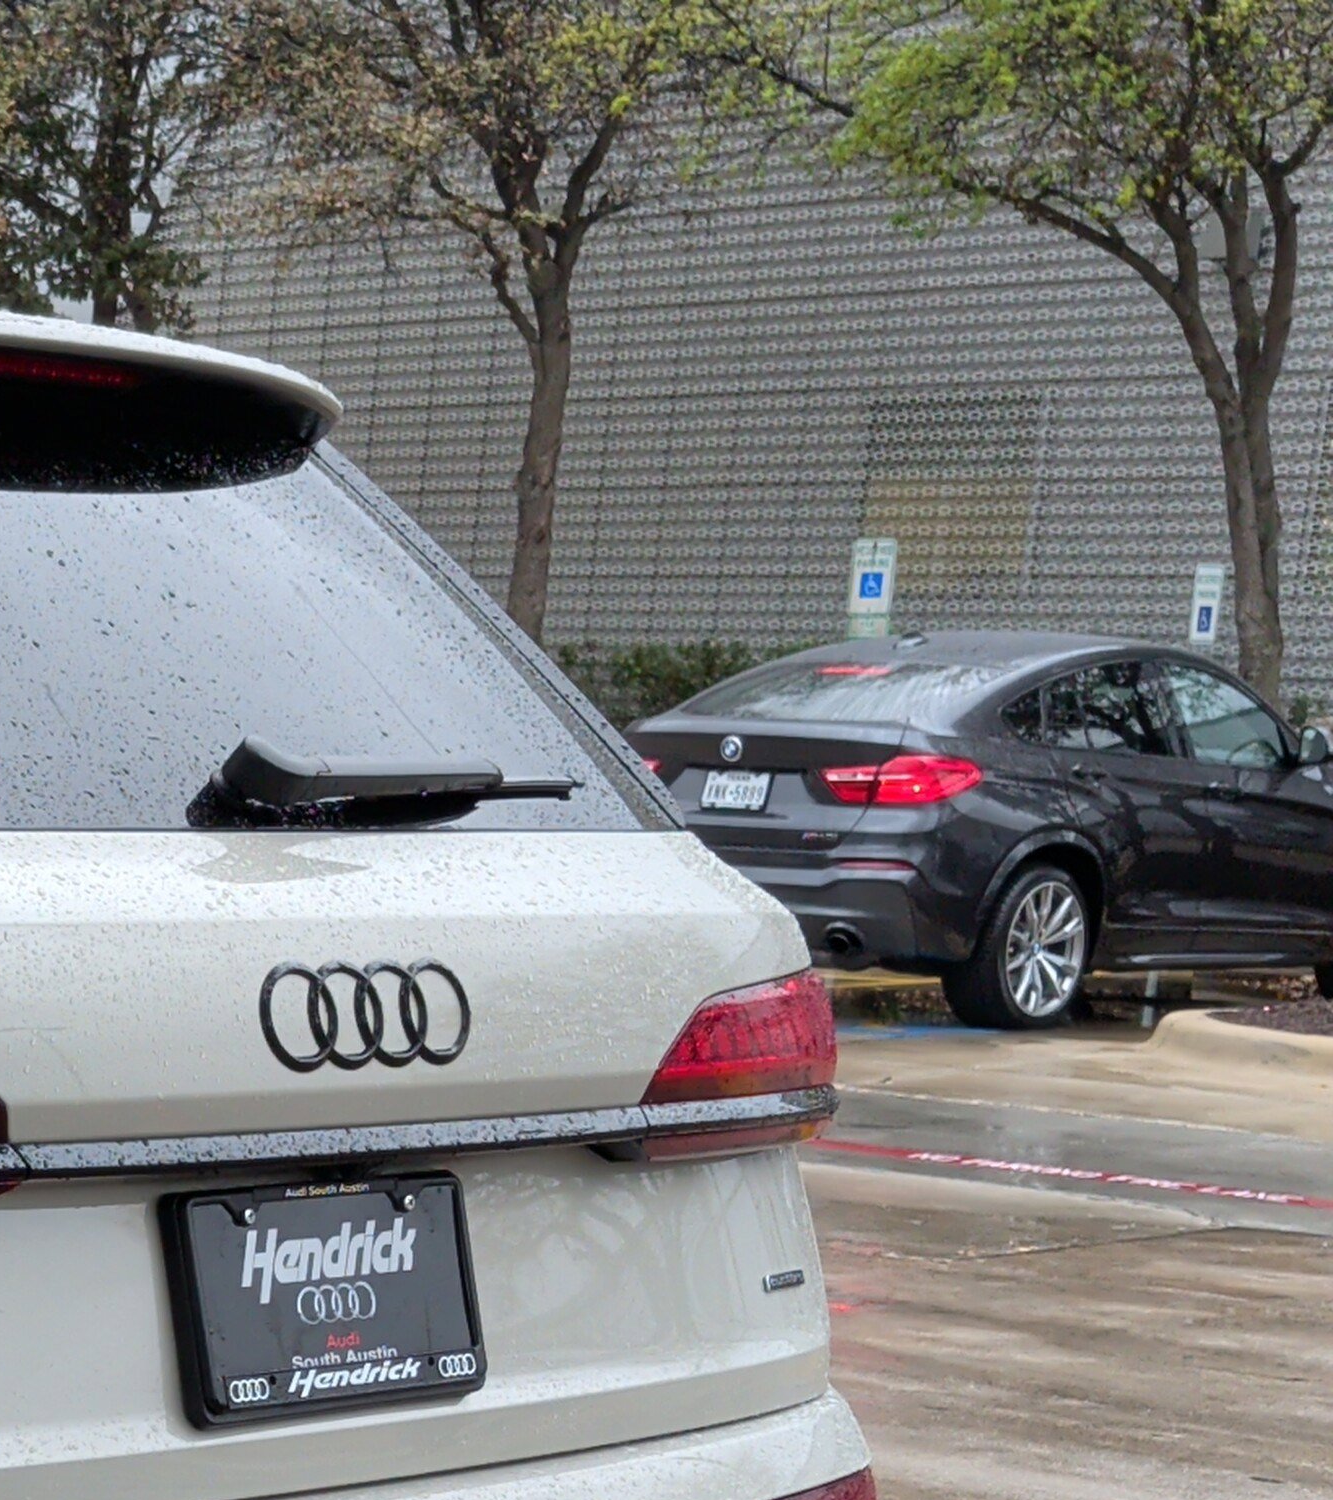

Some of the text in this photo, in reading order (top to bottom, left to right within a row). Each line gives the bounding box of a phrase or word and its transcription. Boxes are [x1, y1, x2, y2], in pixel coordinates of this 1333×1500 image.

[285, 1182, 370, 1198] Audi South Austin
[241, 1216, 417, 1305] Hendrick
[326, 1331, 361, 1348] Audi
[292, 1344, 399, 1370] South Austin
[287, 1356, 422, 1399] Hendrick
